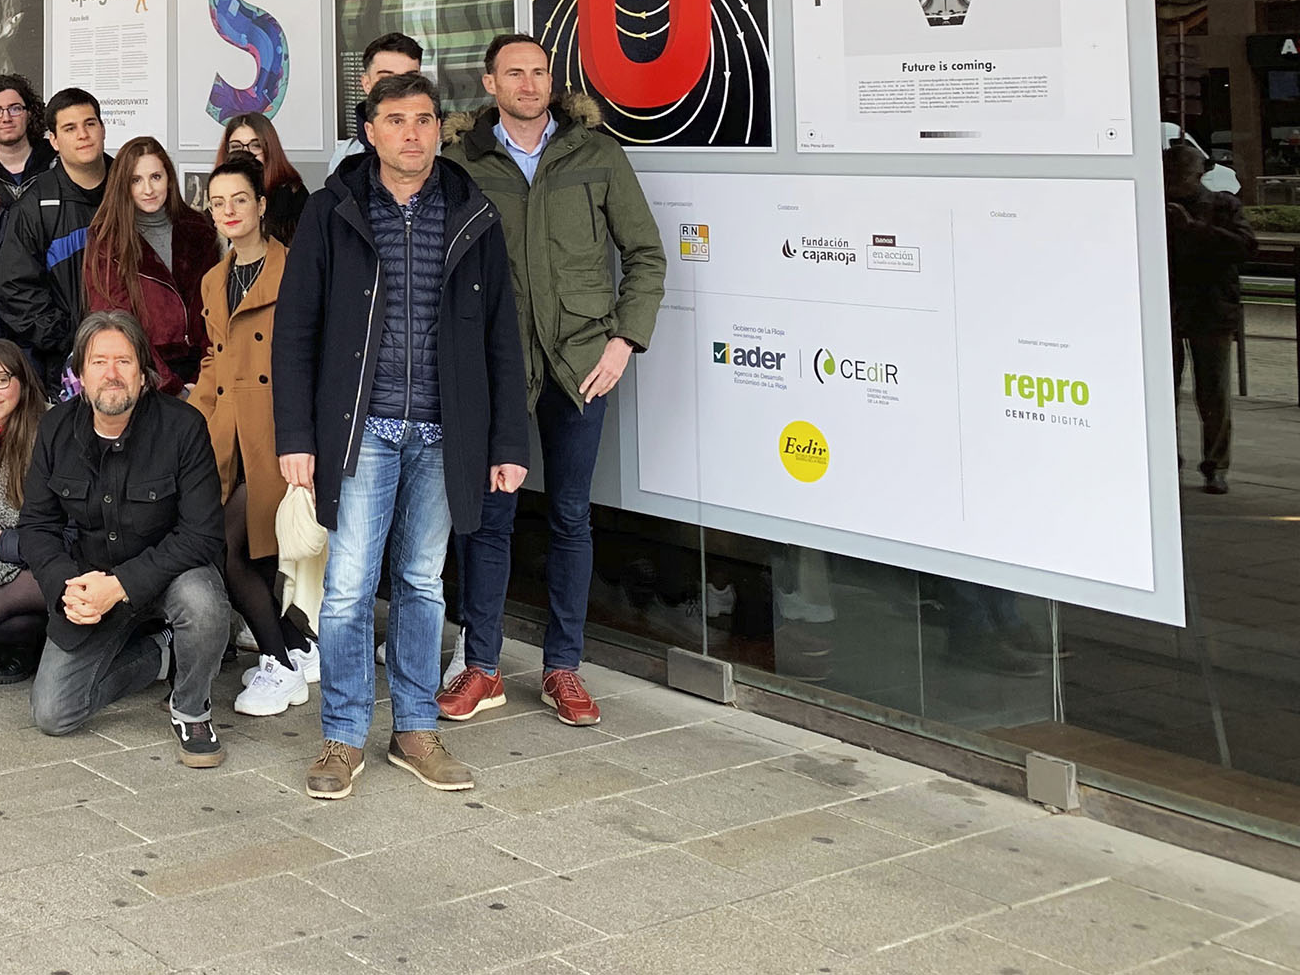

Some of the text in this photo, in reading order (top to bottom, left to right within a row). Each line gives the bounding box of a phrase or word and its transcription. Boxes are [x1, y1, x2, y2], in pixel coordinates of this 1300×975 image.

[901, 59, 996, 73] Future is coming.
[801, 236, 849, 248] Fundación
[872, 250, 914, 261] en acción
[732, 324, 757, 334] Gobierno
[764, 327, 771, 335] La
[732, 346, 786, 371] ader
[840, 359, 899, 385] CEdiR
[1004, 372, 1090, 408] repro
[1005, 409, 1091, 428] CENTRO DIGITAL
[782, 436, 827, 457] Esdir
